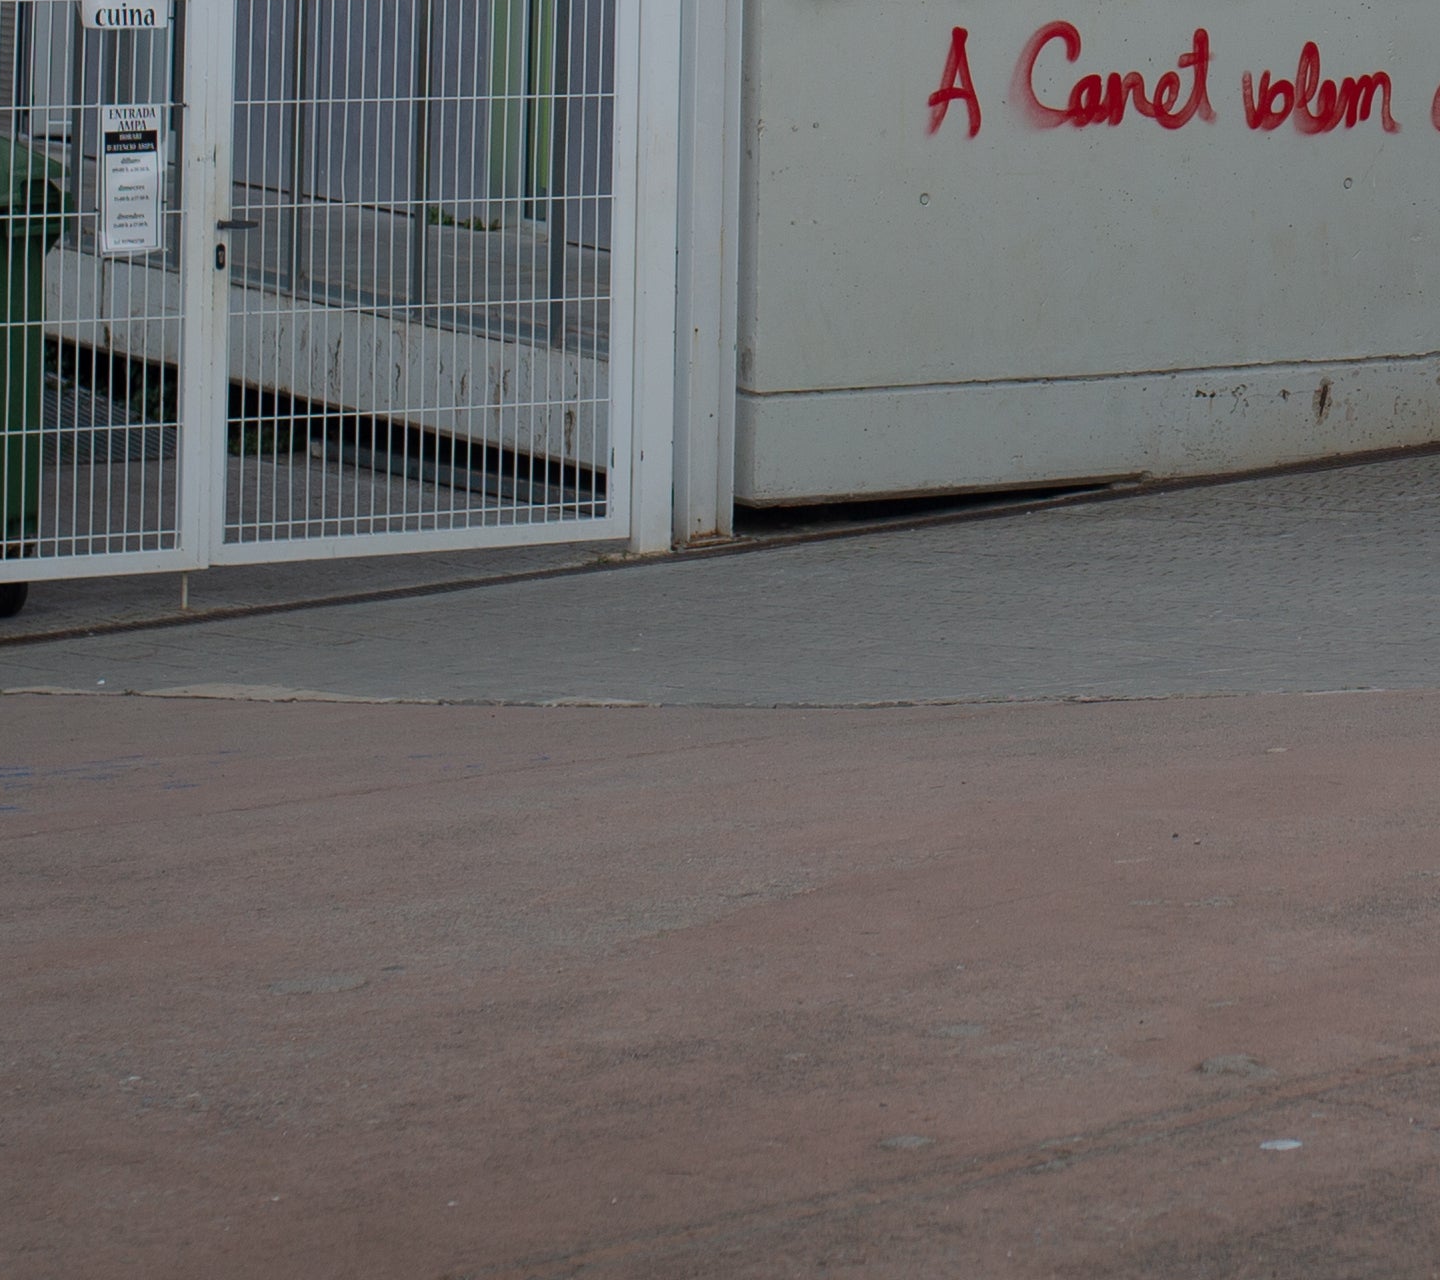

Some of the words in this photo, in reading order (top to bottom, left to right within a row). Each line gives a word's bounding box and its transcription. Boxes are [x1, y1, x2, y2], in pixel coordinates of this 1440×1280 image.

[95, 3, 155, 26] cuina
[926, 26, 983, 139] A
[1012, 20, 1216, 132] Canet
[1241, 41, 1403, 135] volem
[109, 107, 156, 120] ENTRADA
[118, 120, 147, 131] AMPA
